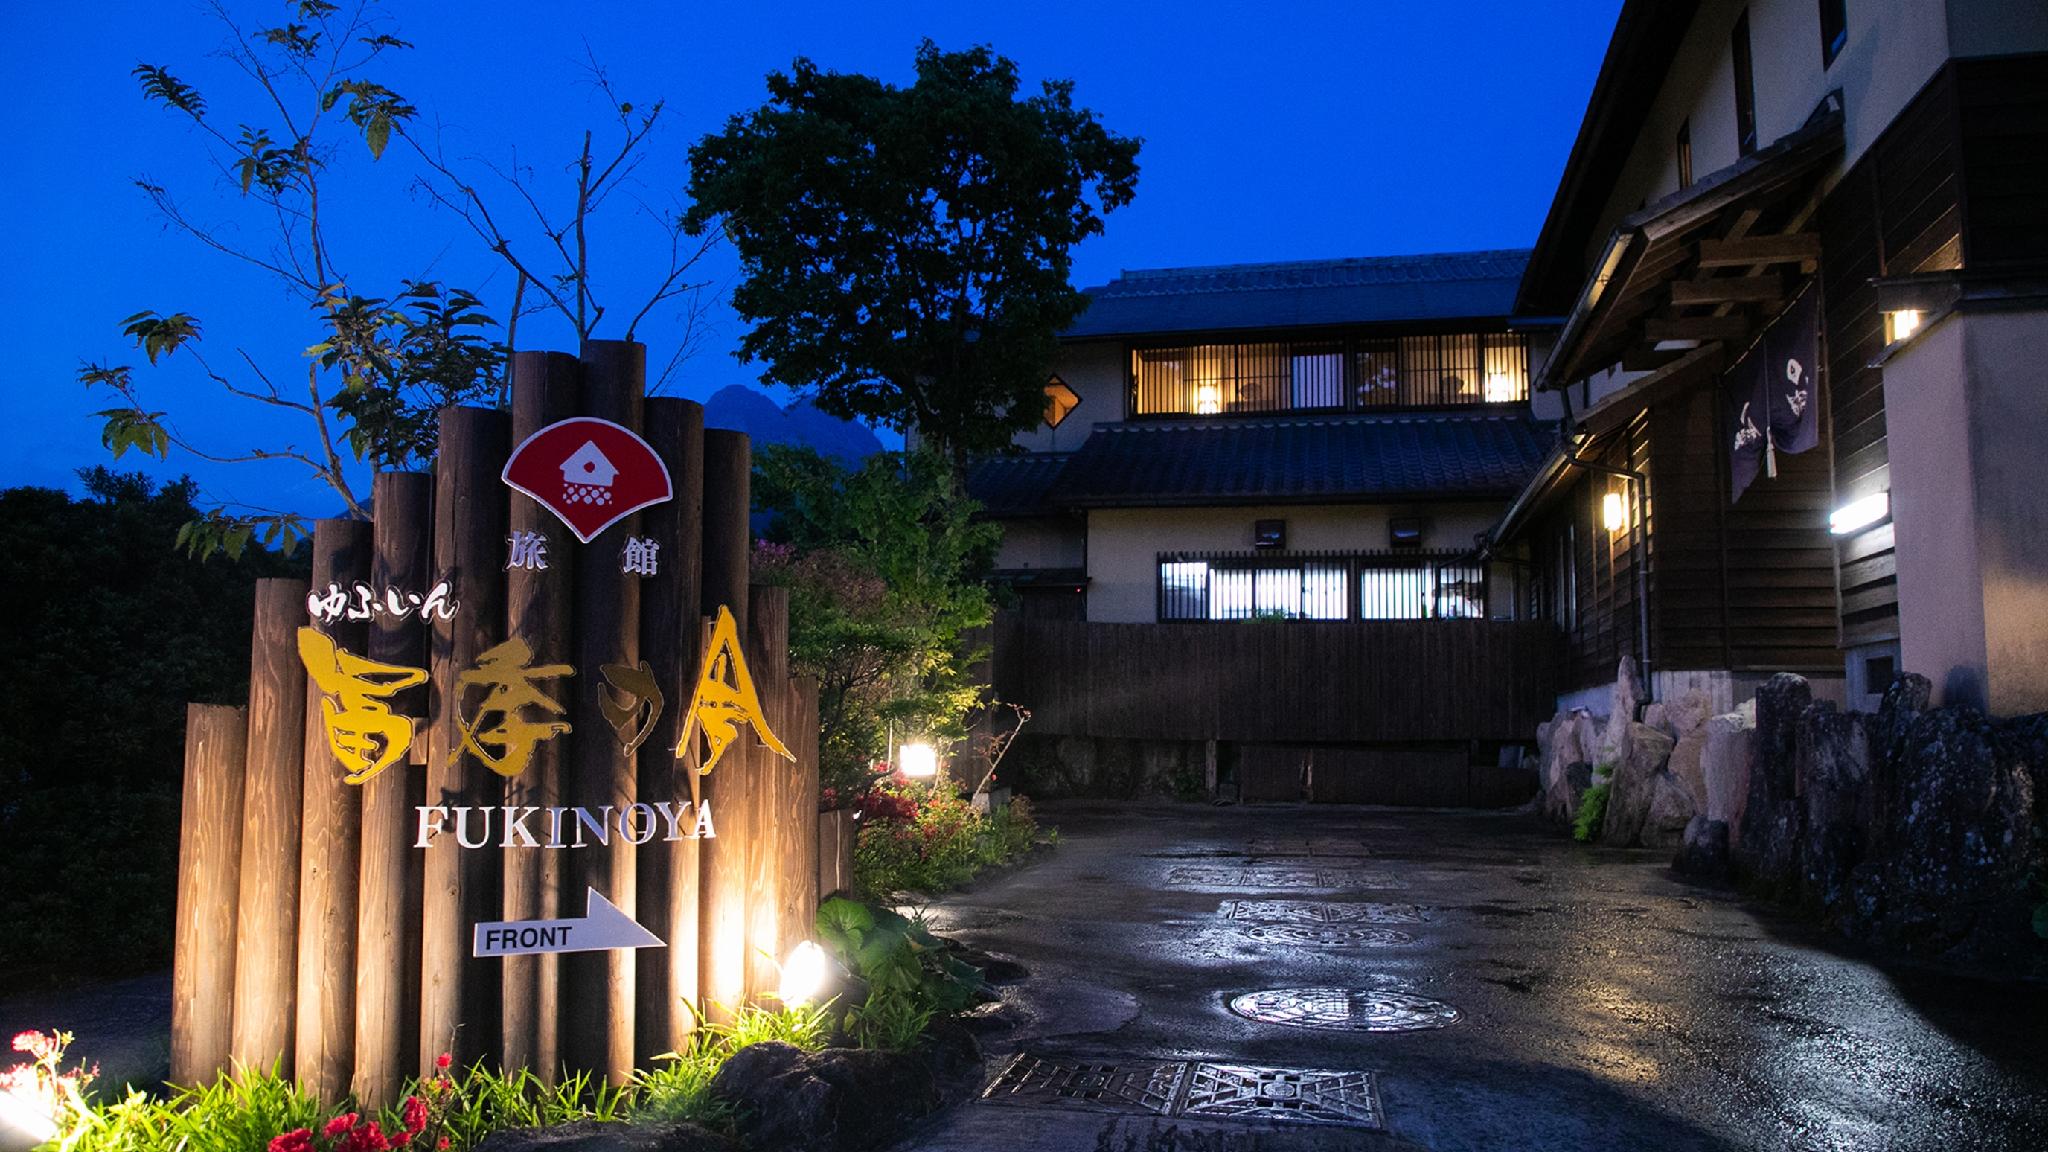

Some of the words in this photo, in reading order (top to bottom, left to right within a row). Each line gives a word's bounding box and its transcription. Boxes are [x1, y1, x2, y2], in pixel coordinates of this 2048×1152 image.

[506, 531, 660, 576] 旅館
[308, 582, 460, 622] ゆふいん
[413, 799, 717, 849] FUKINOYA
[485, 926, 573, 950] FRONT
